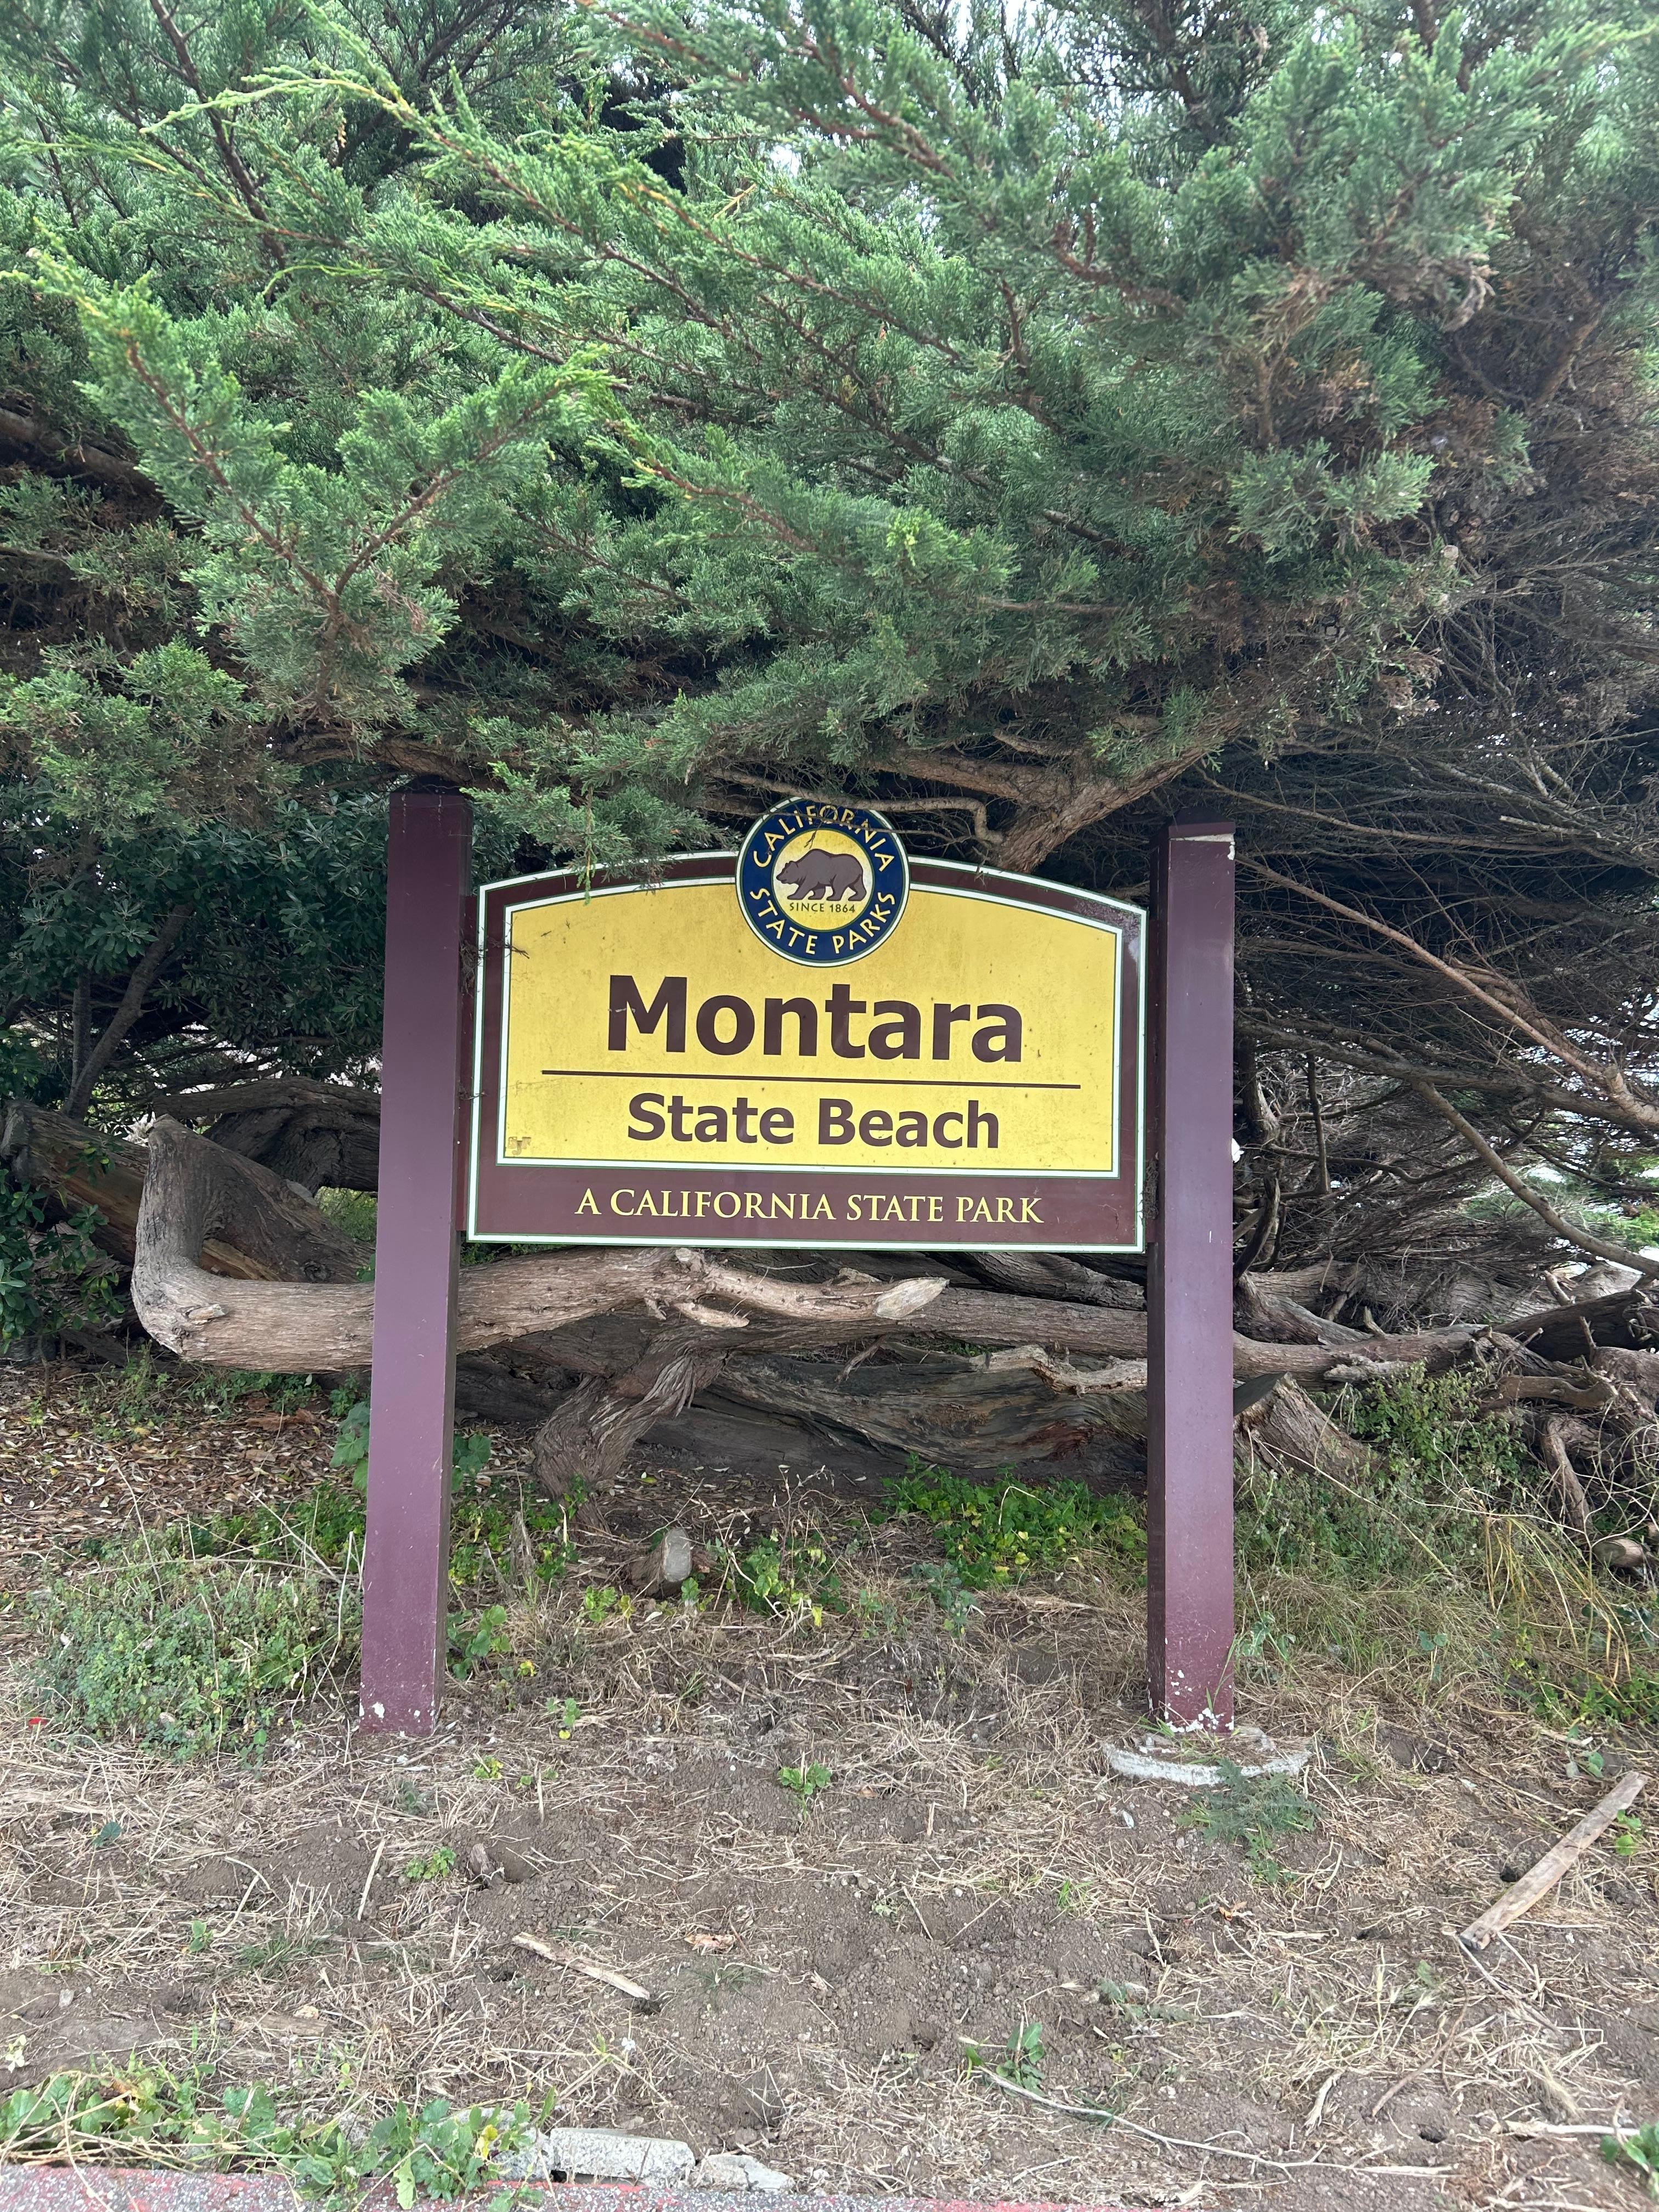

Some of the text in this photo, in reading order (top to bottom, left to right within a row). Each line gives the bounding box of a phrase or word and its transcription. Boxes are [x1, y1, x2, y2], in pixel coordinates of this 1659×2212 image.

[753, 805, 895, 872] CALIFORNIA
[749, 888, 895, 955] STATE PARKS
[789, 902, 856, 913] SINCE 1864
[607, 974, 1023, 1063] Montara
[627, 1092, 1000, 1149] State Beach
[574, 1188, 1045, 1223] A CALIFORNIA STATE PARK
